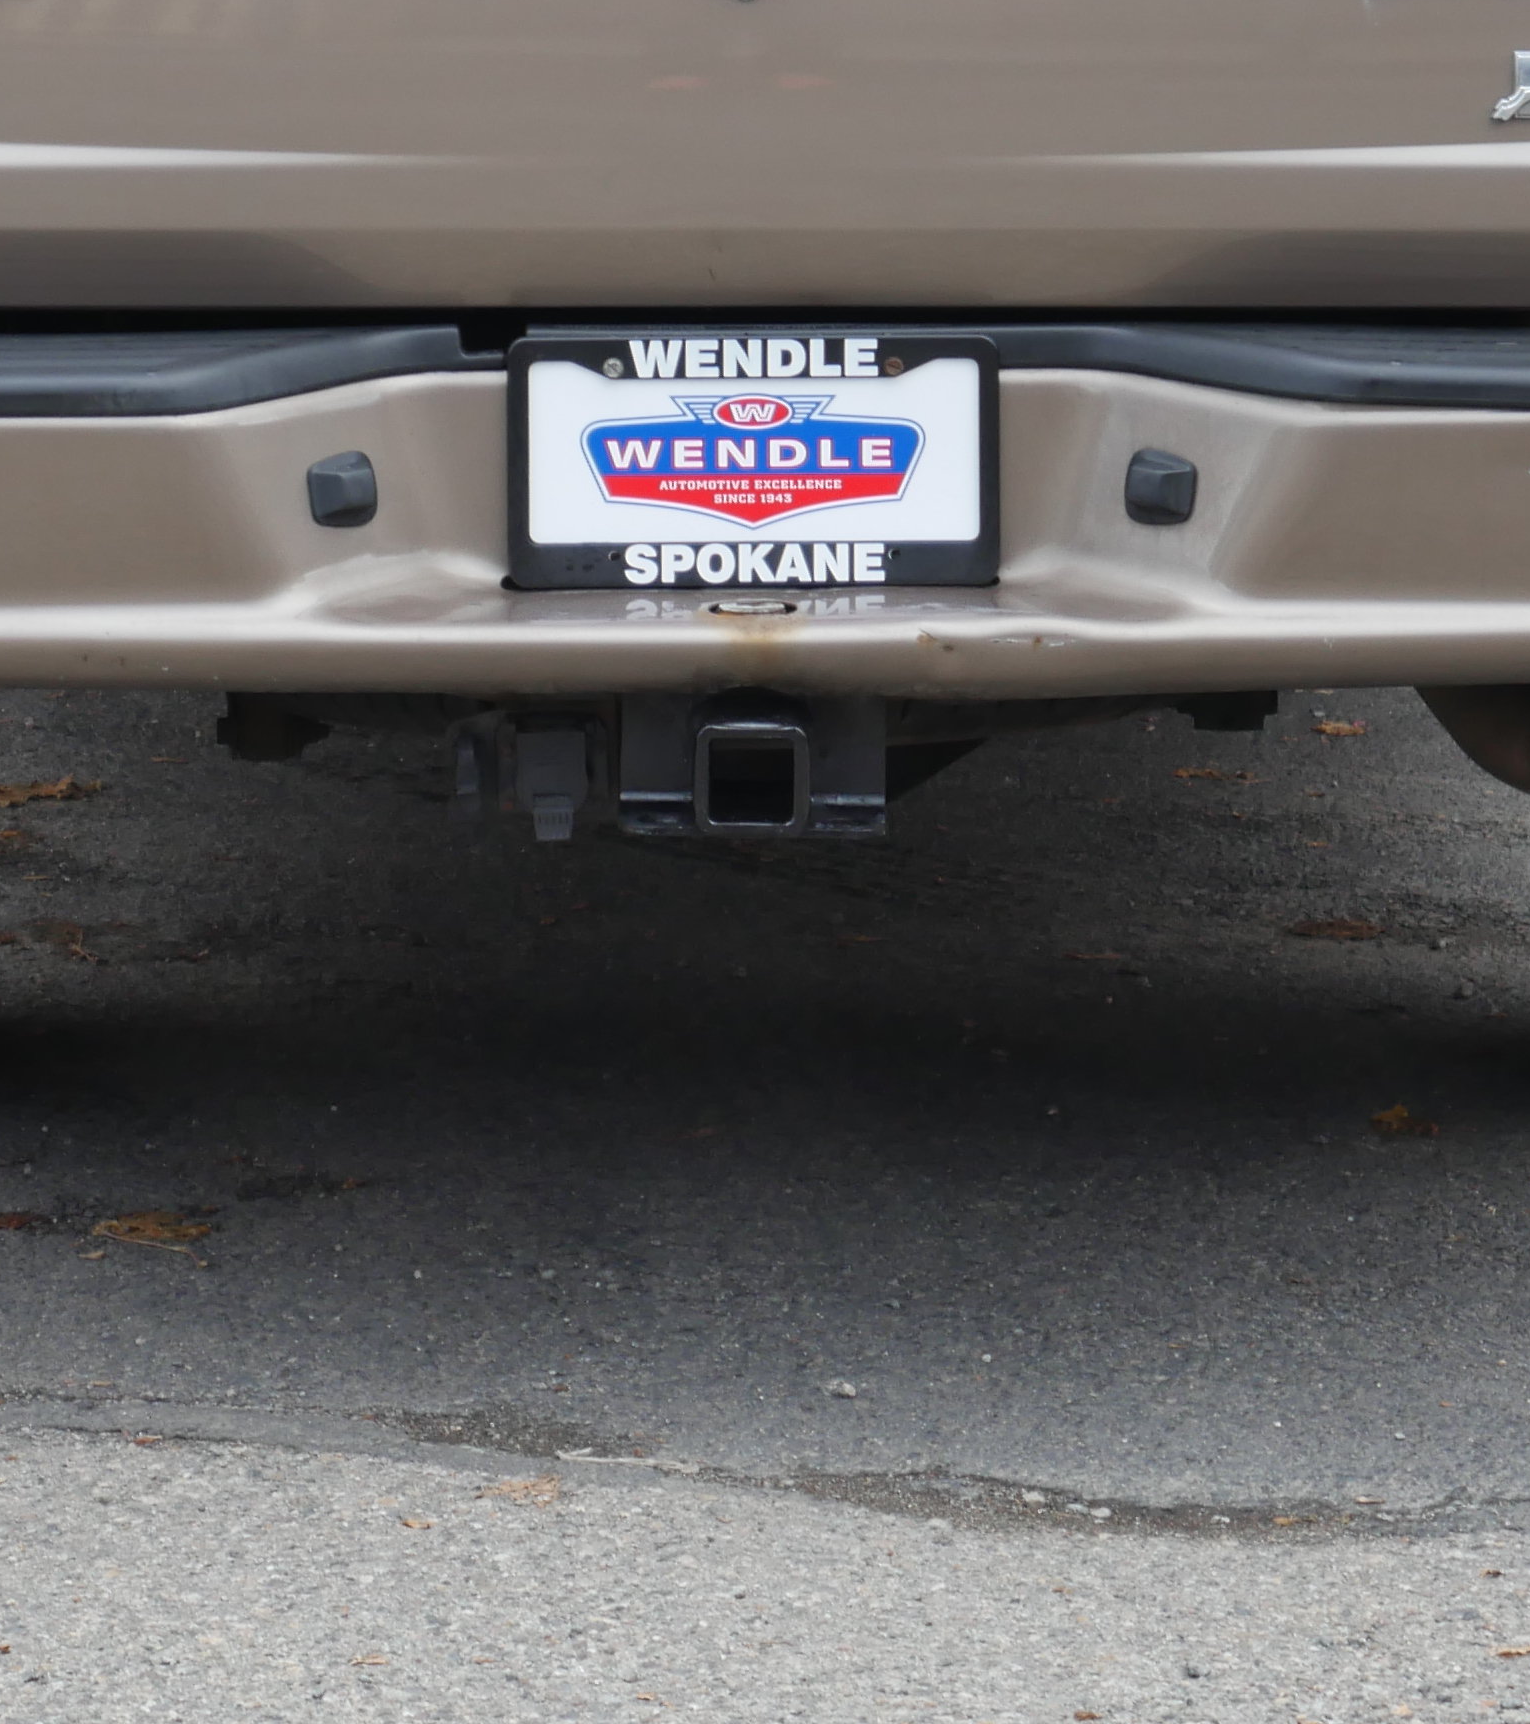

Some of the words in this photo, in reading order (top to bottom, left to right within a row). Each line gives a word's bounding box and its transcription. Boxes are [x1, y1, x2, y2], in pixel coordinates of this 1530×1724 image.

[629, 338, 879, 378] WENDLE
[605, 438, 893, 469] WENDLE
[659, 479, 750, 491] AUTOMOTIVE
[754, 479, 843, 490] EXCELLENCE
[714, 493, 756, 505] SINCE
[760, 493, 793, 504] 1943
[624, 542, 886, 584] SPOKANE
